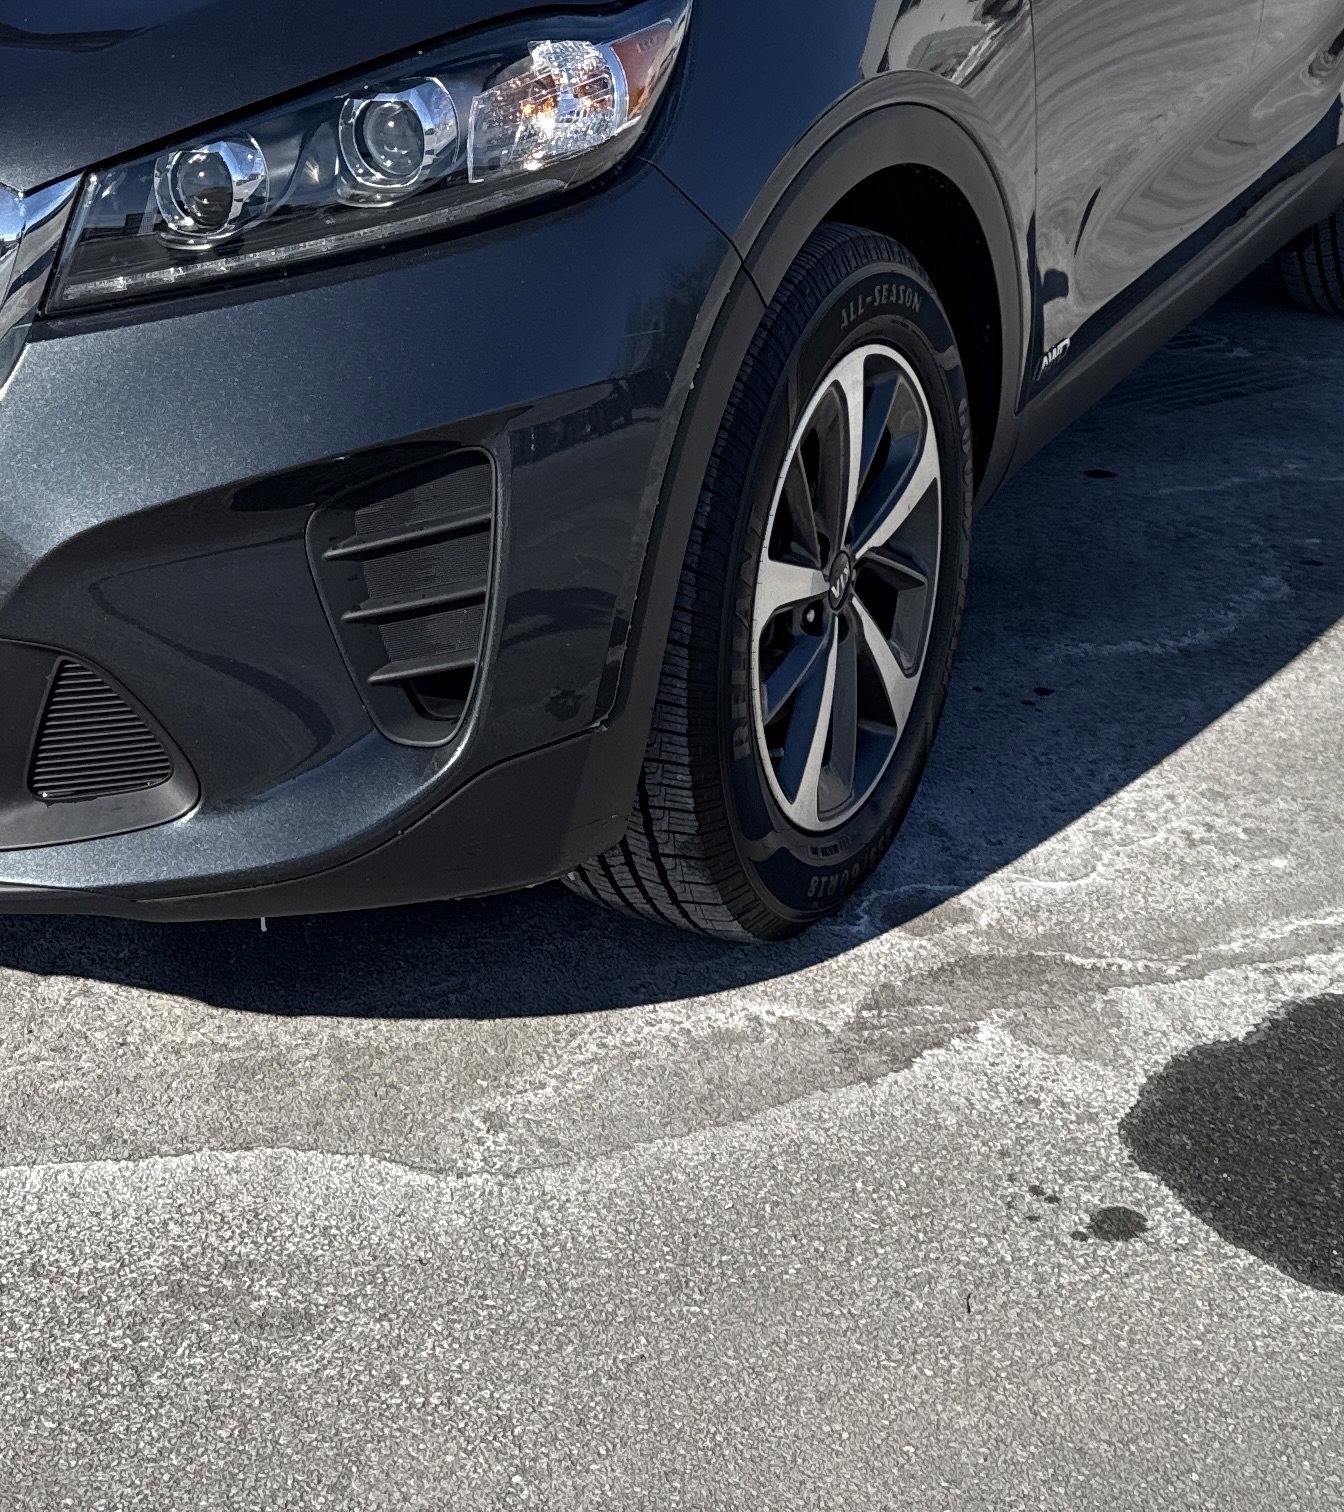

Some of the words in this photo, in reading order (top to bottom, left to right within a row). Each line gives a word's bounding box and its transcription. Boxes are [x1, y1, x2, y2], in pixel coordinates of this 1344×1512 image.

[840, 283, 923, 334] ALL-SEASON
[1036, 337, 1071, 381] AWD
[730, 502, 764, 762] RELIANT
